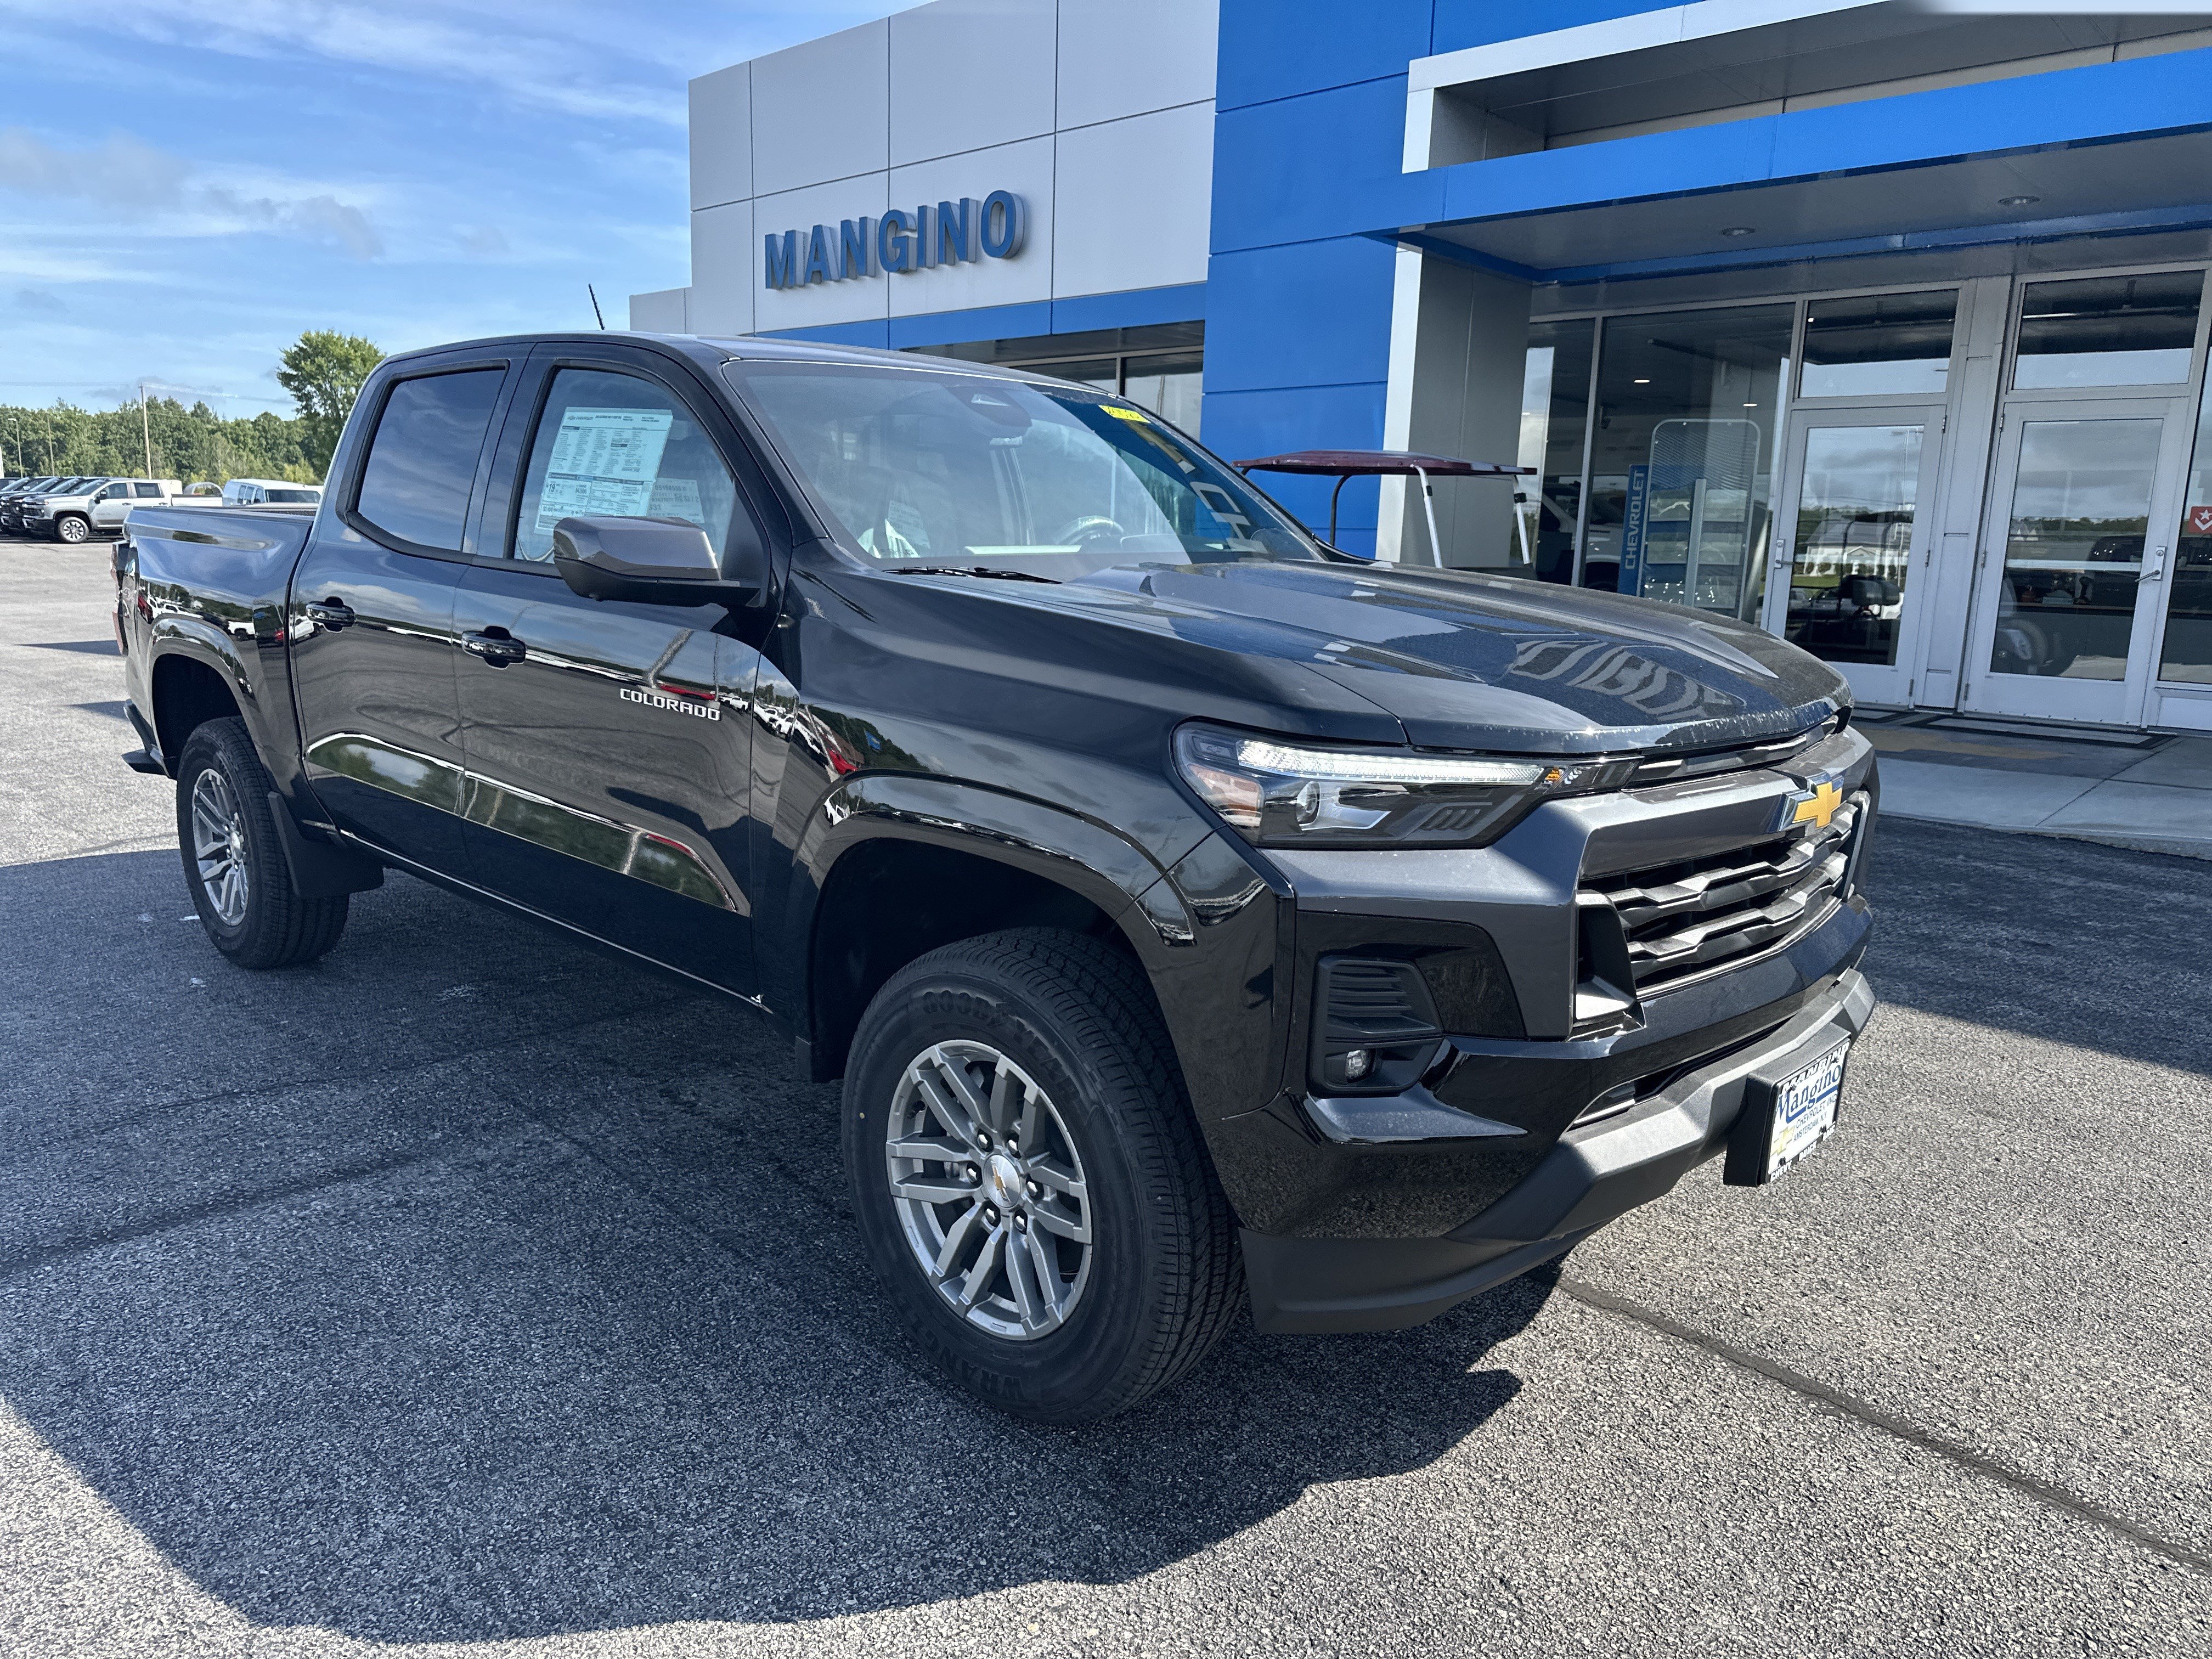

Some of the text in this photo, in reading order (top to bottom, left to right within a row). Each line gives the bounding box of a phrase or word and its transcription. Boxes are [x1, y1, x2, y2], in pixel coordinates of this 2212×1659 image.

[765, 189, 1024, 290] MANGINO
[1625, 470, 1644, 569] CHEVROLET
[620, 688, 721, 721] COLORADO
[922, 990, 1081, 1103] GOODYEAR
[1776, 1065, 1842, 1124] Mangino
[1770, 1160, 1792, 1182] CHEVY
